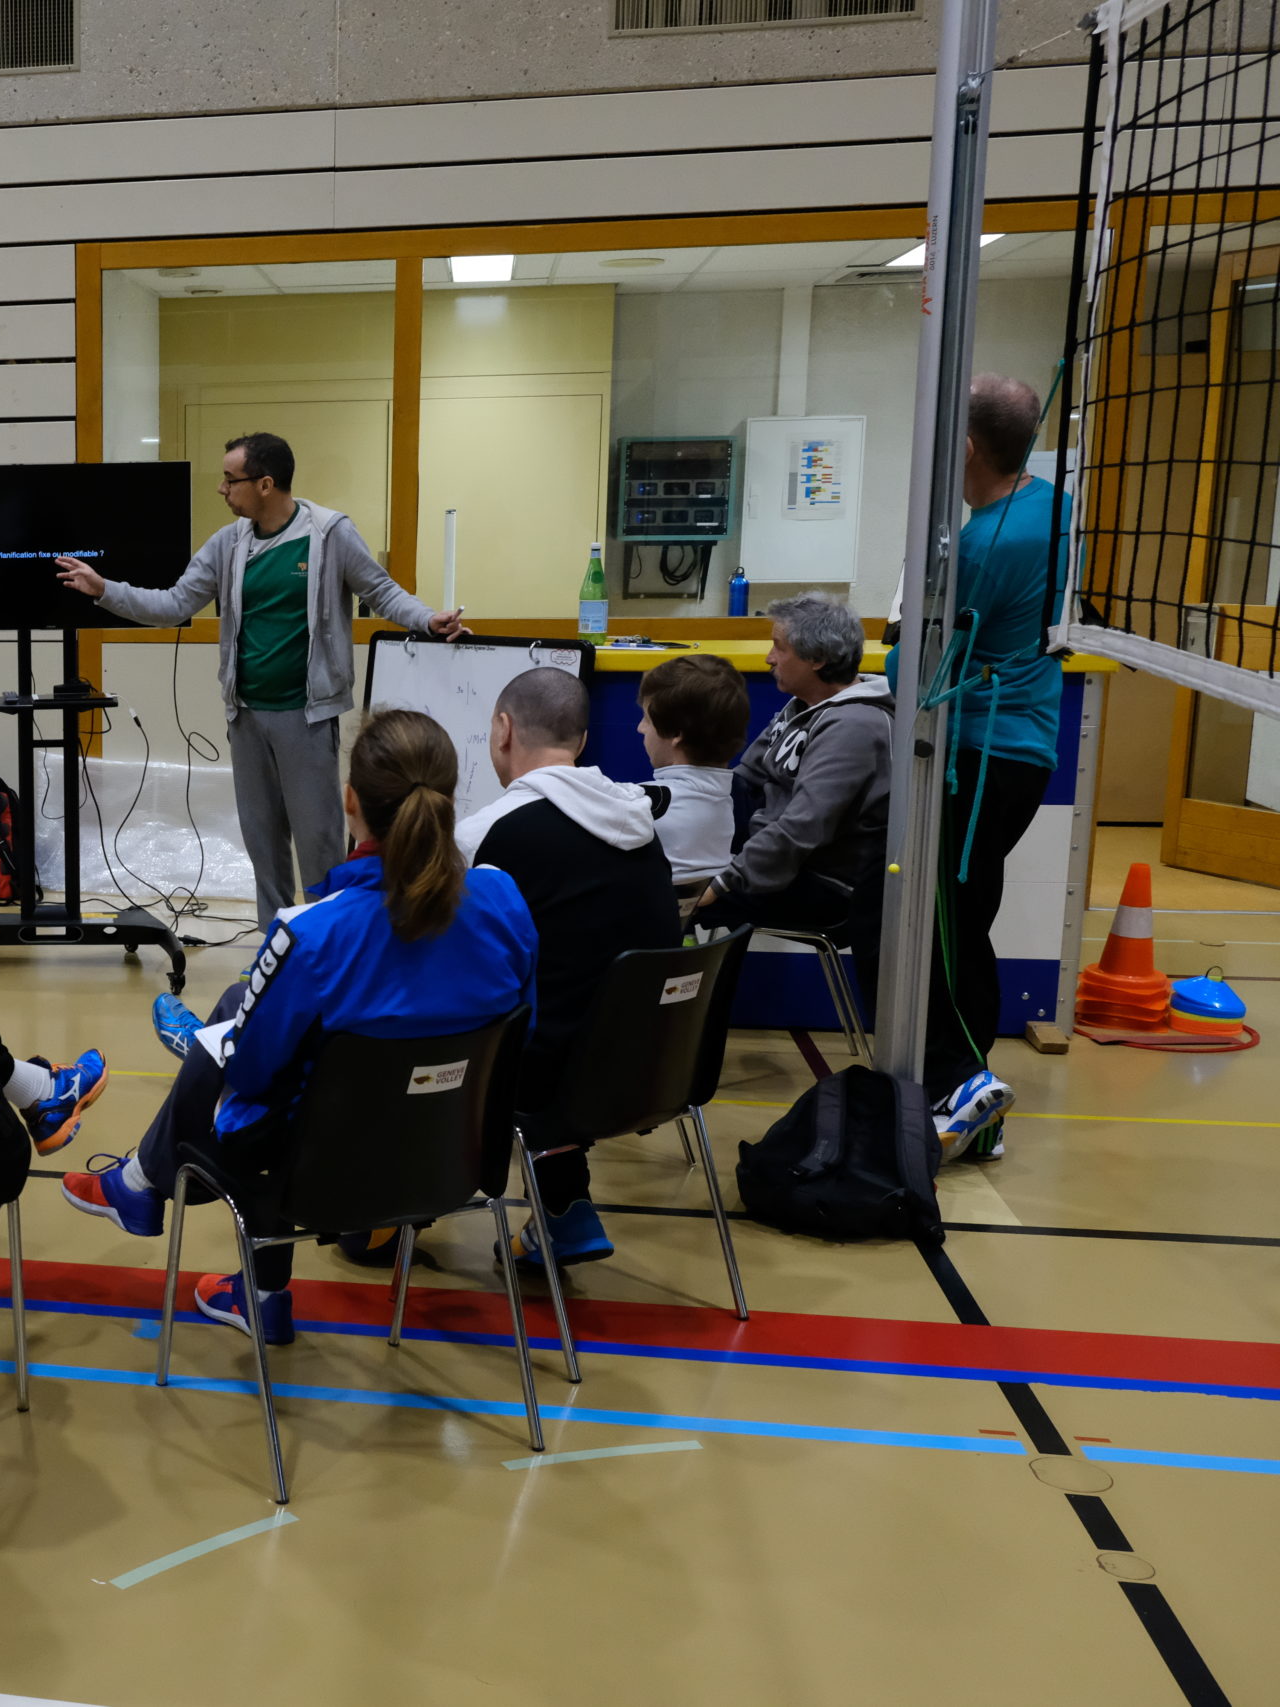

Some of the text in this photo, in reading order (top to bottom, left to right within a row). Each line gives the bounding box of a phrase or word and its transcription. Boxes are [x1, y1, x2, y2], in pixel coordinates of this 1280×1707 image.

[930, 214, 938, 246] LUZERN
[38, 550, 51, 558] fixe
[62, 549, 99, 558] modifiable
[99, 549, 105, 557] ?
[435, 1073, 463, 1085] VOLLEY
